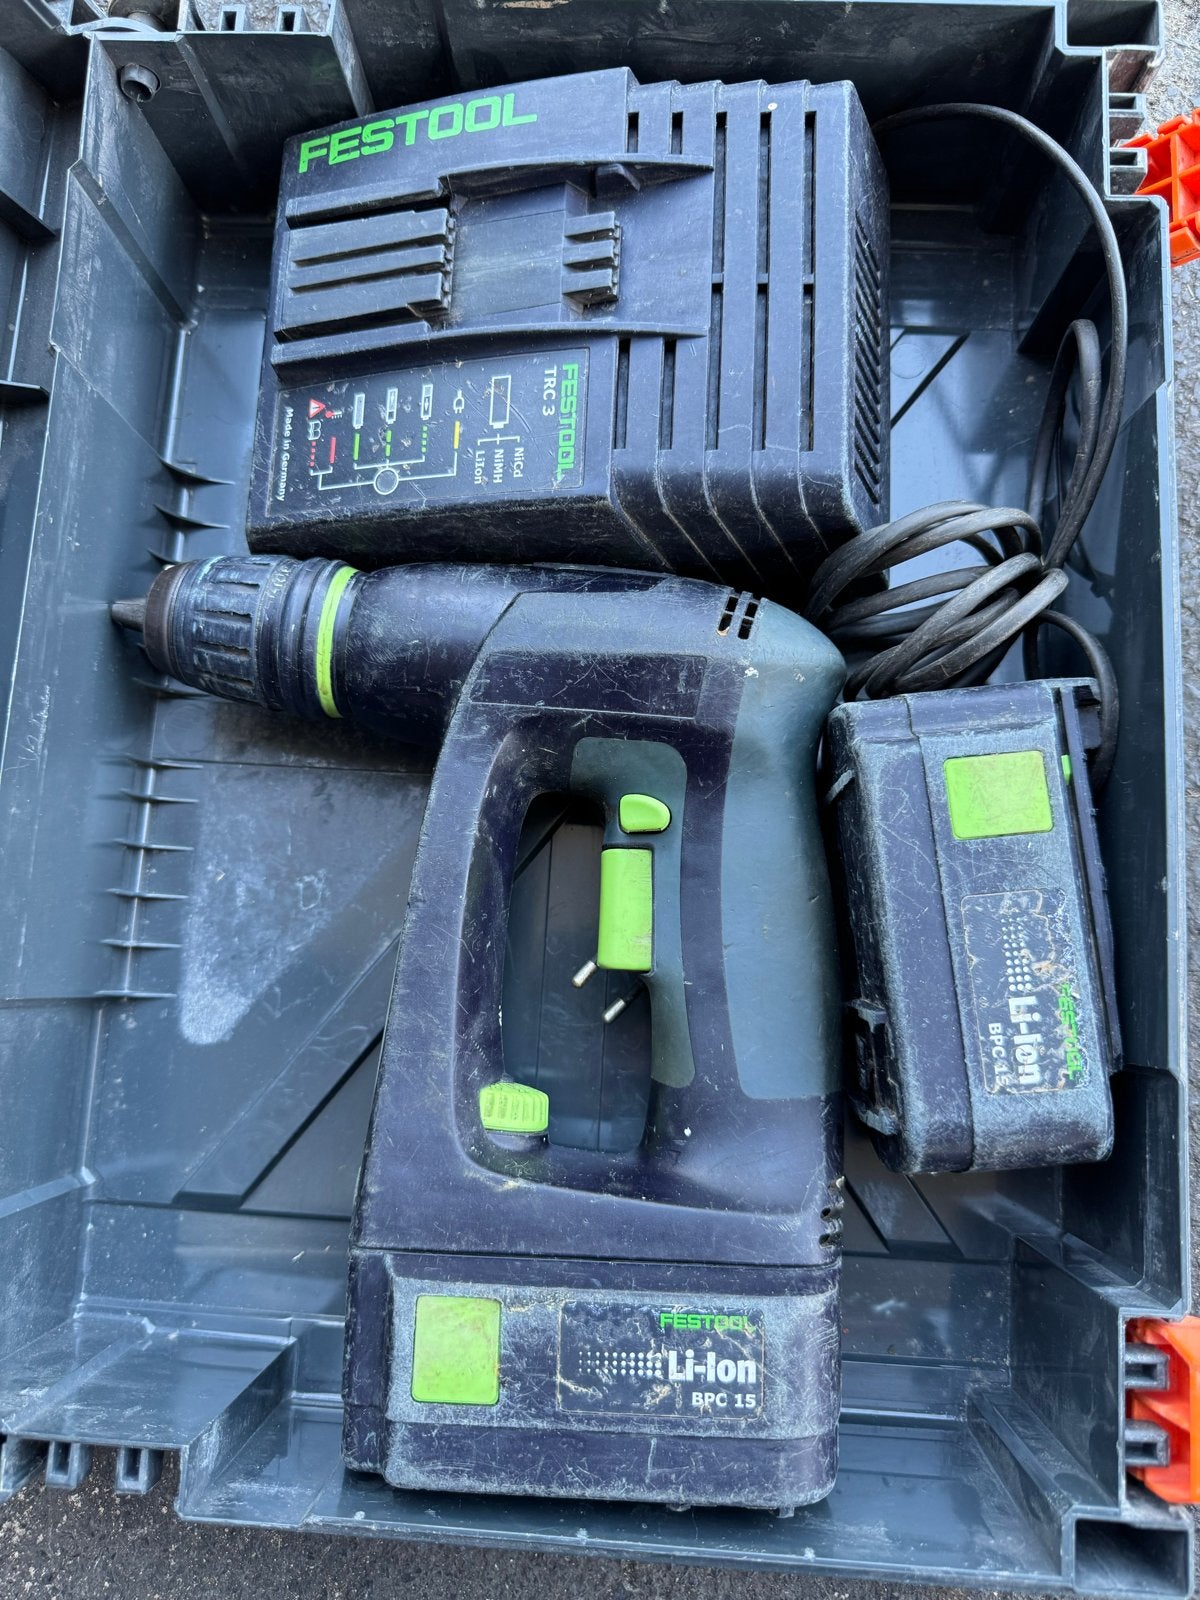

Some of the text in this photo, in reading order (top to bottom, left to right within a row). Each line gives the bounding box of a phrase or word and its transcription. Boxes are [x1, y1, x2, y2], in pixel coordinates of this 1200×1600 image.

[298, 93, 538, 174] FESTOOL
[542, 366, 557, 417] TRC 3
[556, 362, 579, 481] FESTOOL
[277, 406, 294, 501] Made in Germany
[474, 450, 486, 485] LiIon
[492, 448, 504, 484] NiMH
[513, 447, 525, 478] NiCd
[989, 1022, 1007, 1058] BPC
[1008, 995, 1042, 1085] Li-Ion
[659, 1312, 757, 1332] FESTOOL
[668, 1349, 757, 1384] Li-Ion
[691, 1391, 757, 1408] BPC 15
